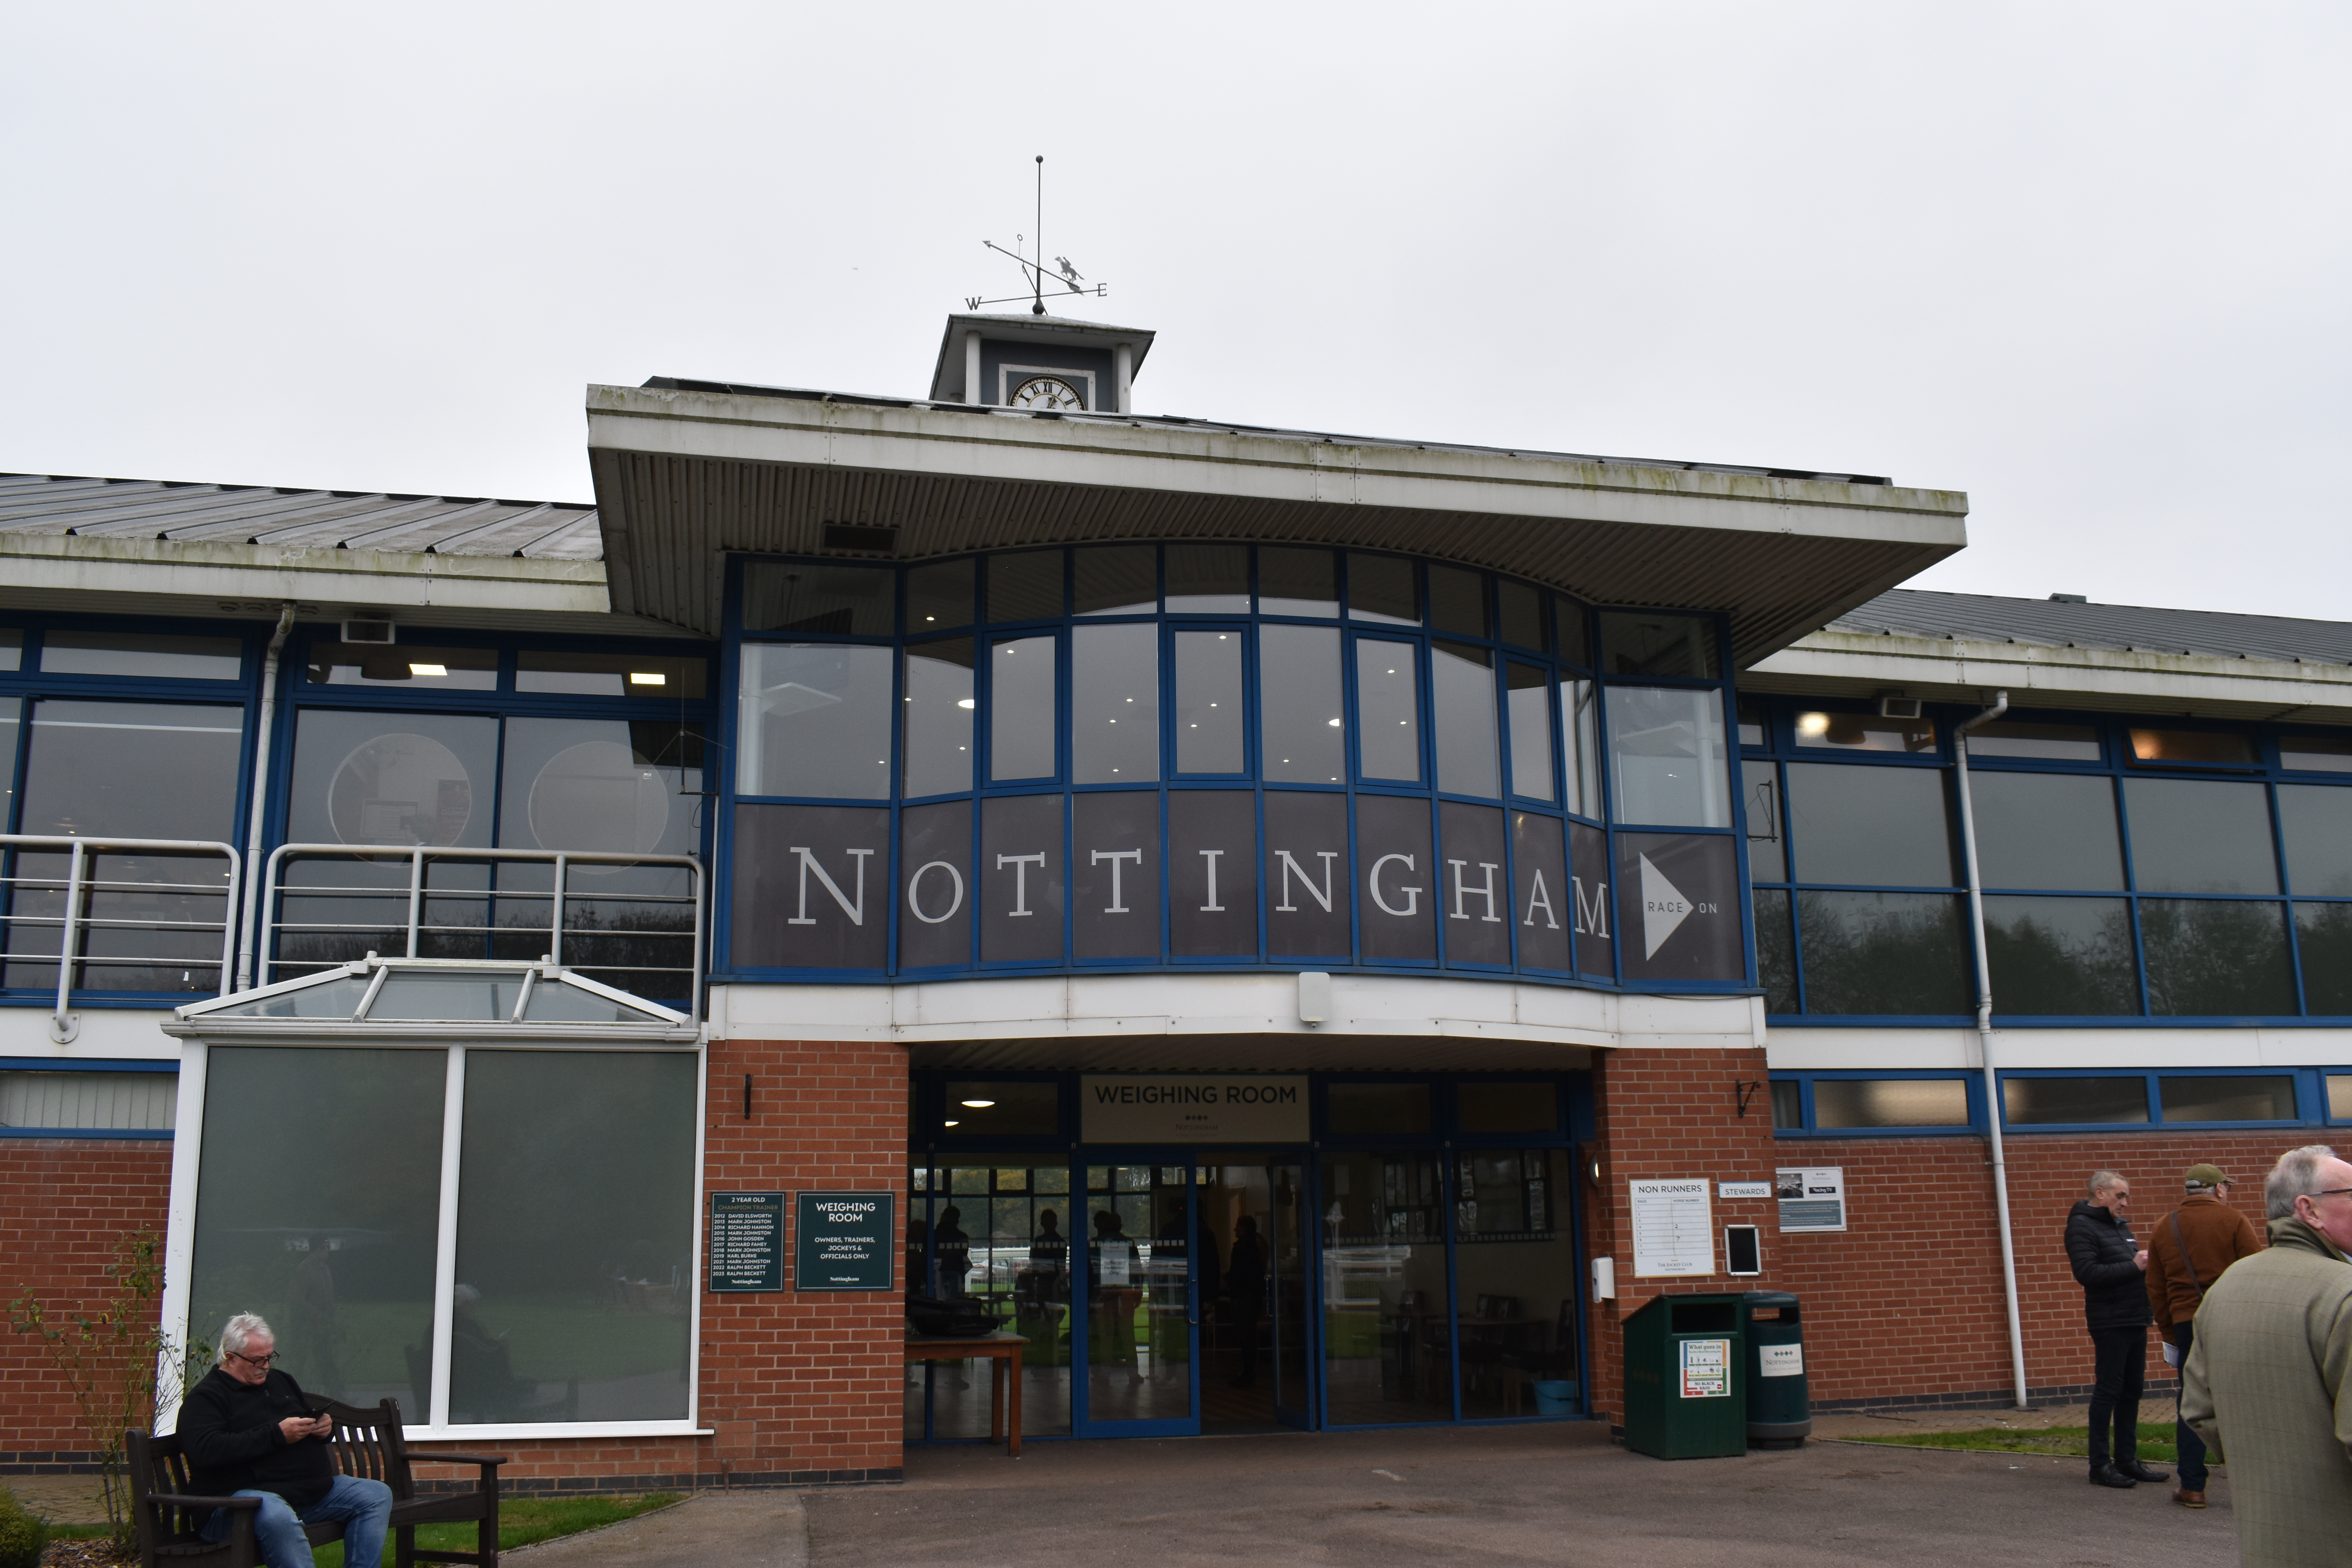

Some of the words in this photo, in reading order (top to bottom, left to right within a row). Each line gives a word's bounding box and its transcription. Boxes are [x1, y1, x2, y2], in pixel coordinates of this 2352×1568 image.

[1097, 283, 1107, 296] E
[965, 296, 982, 310] W
[1043, 382, 1052, 393] XII
[787, 847, 1612, 940] NOTTINGHAM
[1648, 902, 1683, 913] RACE
[1699, 903, 1717, 913] ON
[1095, 1086, 1218, 1103] WEIGHING
[1227, 1086, 1296, 1103] ROOM
[1661, 1185, 1702, 1193] RUNNERS
[816, 1203, 876, 1211] WEIGHING
[829, 1213, 862, 1222] ROOM
